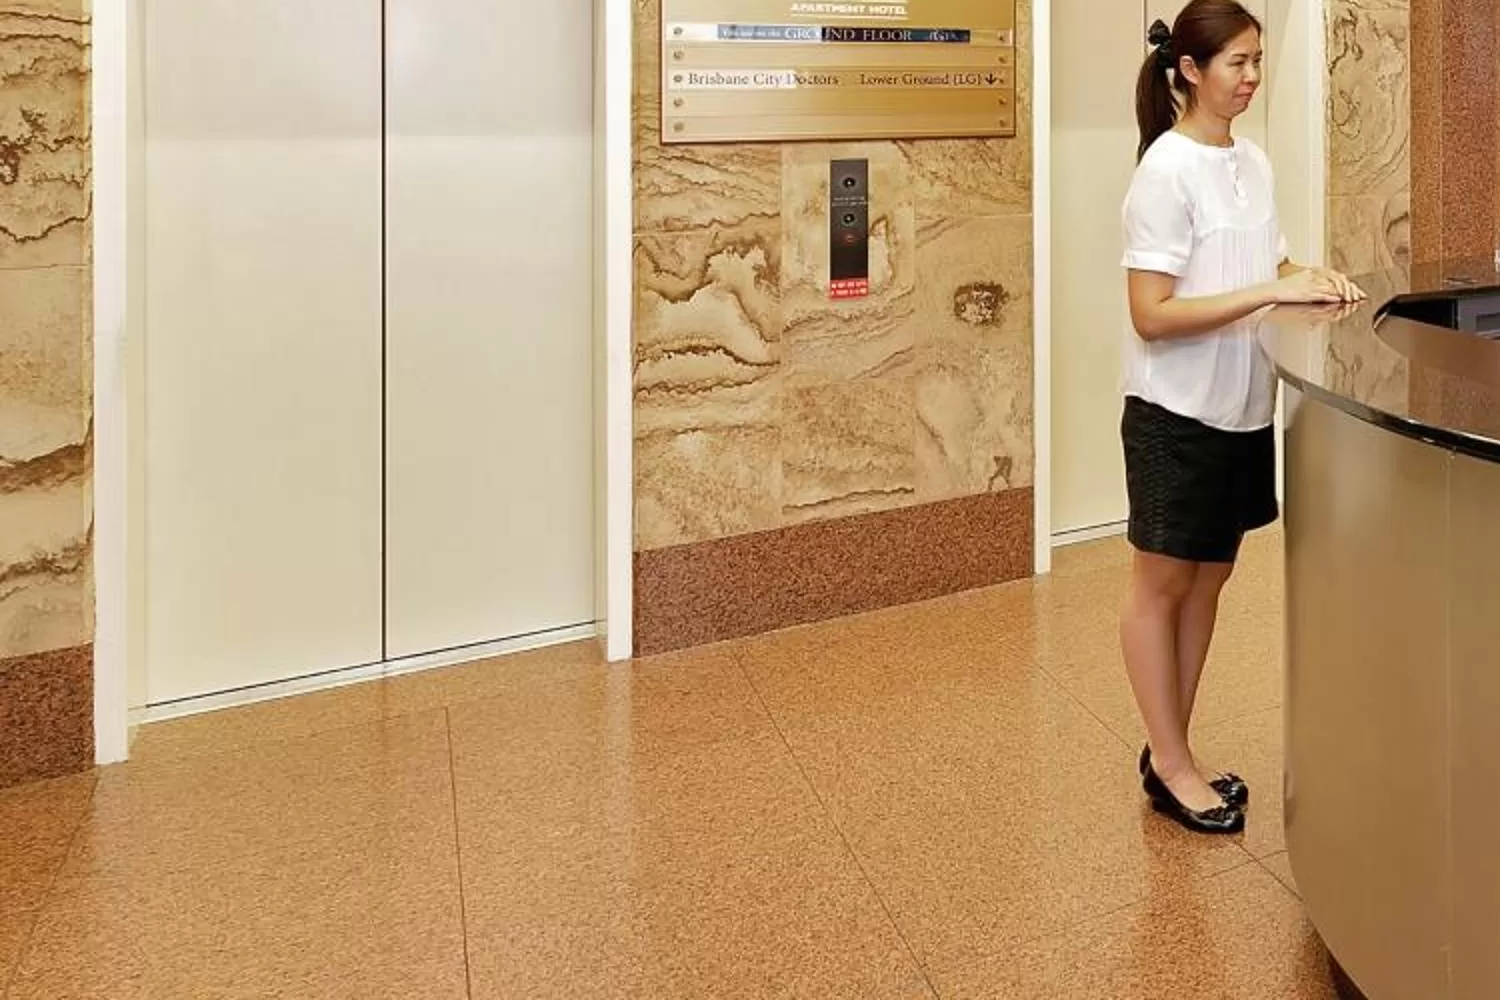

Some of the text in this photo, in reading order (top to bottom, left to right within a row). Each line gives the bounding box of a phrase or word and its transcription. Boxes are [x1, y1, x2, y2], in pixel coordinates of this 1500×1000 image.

[790, 3, 908, 15] APARTMENT HOTEL
[863, 29, 912, 41] FLOOR
[688, 72, 840, 87] Brisbane City Doctors
[860, 74, 899, 85] Lower
[901, 73, 949, 85] Ground
